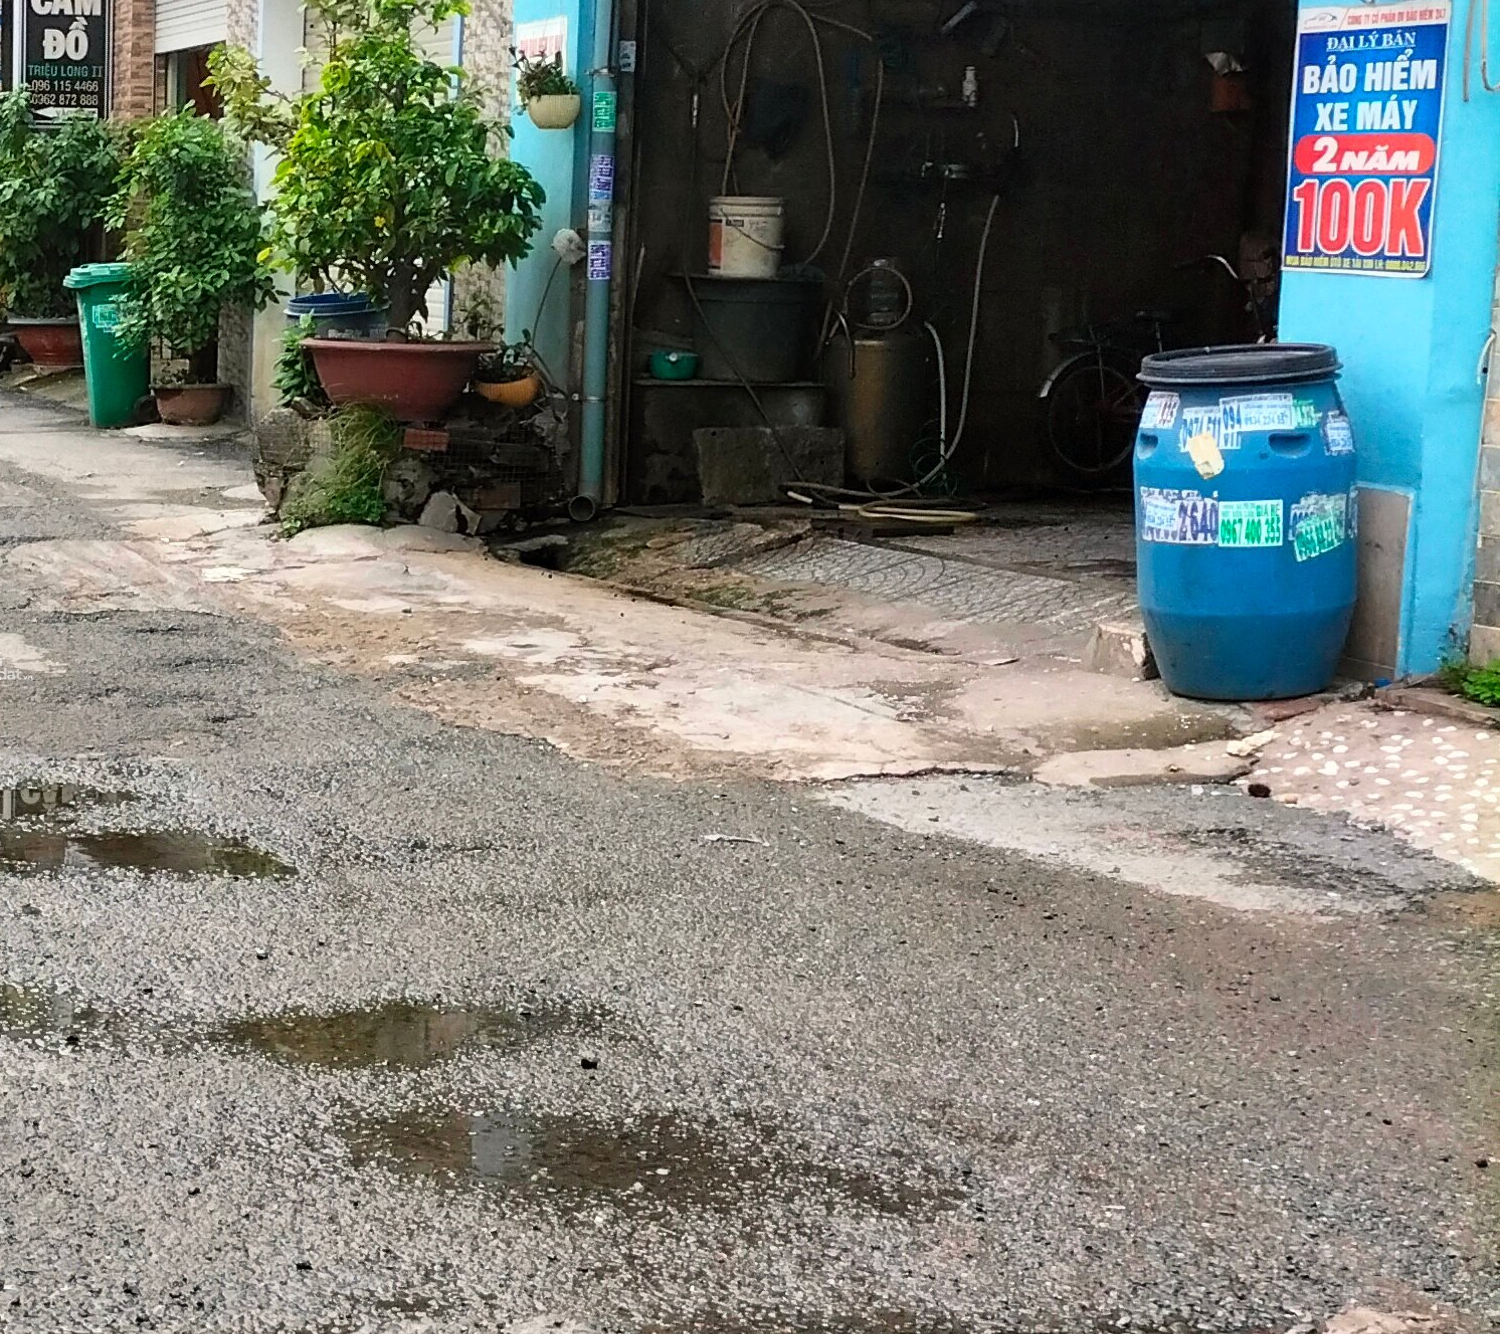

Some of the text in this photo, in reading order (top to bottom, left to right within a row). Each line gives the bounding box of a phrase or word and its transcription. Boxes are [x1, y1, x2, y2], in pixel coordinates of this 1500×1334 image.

[42, 17, 89, 61] ĐỒ
[1327, 29, 1417, 52] ĐẠI LÝ BÁN
[54, 80, 72, 92] 115
[61, 66, 89, 78] LONG
[1303, 48, 1438, 95] BẢO HIỂM
[1314, 94, 1418, 132] XE MÁY
[1312, 136, 1420, 172] 2 NĂM
[1294, 178, 1431, 257] 100K
